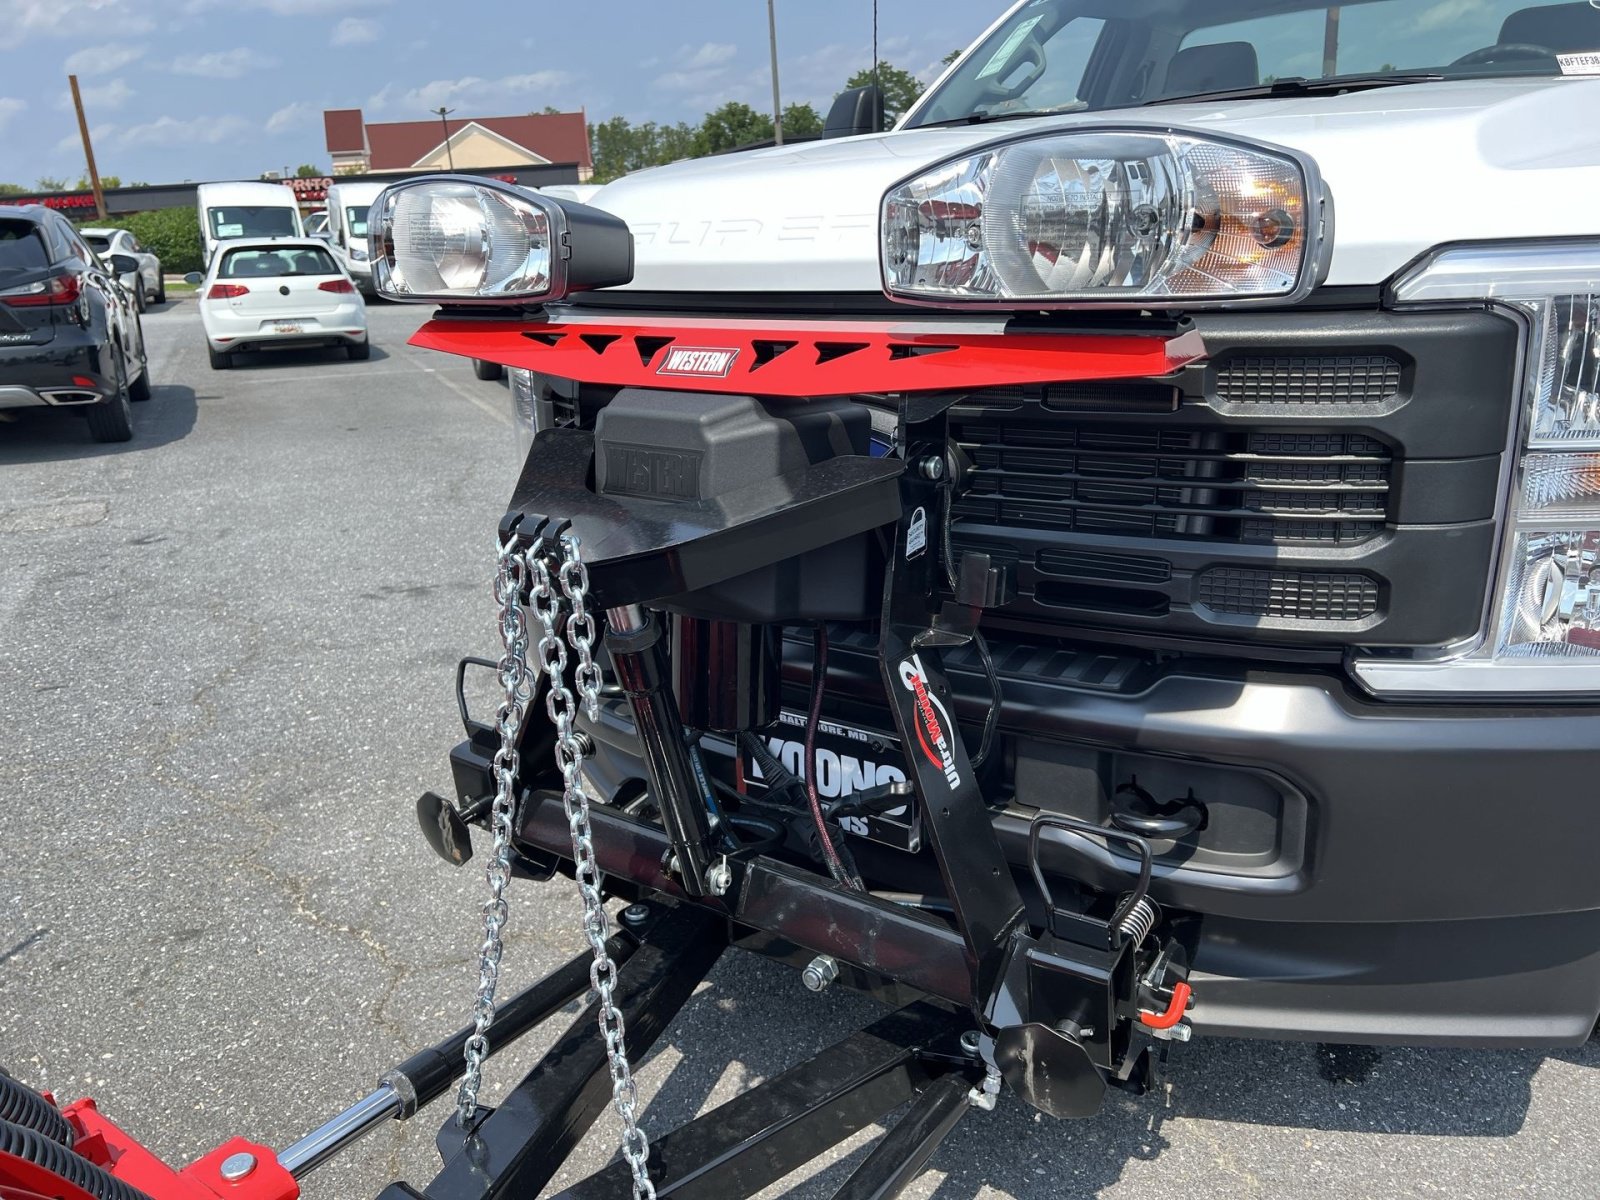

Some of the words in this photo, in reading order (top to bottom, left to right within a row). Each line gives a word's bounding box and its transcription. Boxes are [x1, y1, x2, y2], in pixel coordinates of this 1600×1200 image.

[1558, 56, 1600, 67] KBFTEF38
[666, 351, 731, 372] WESTERN
[847, 730, 868, 742] MD
